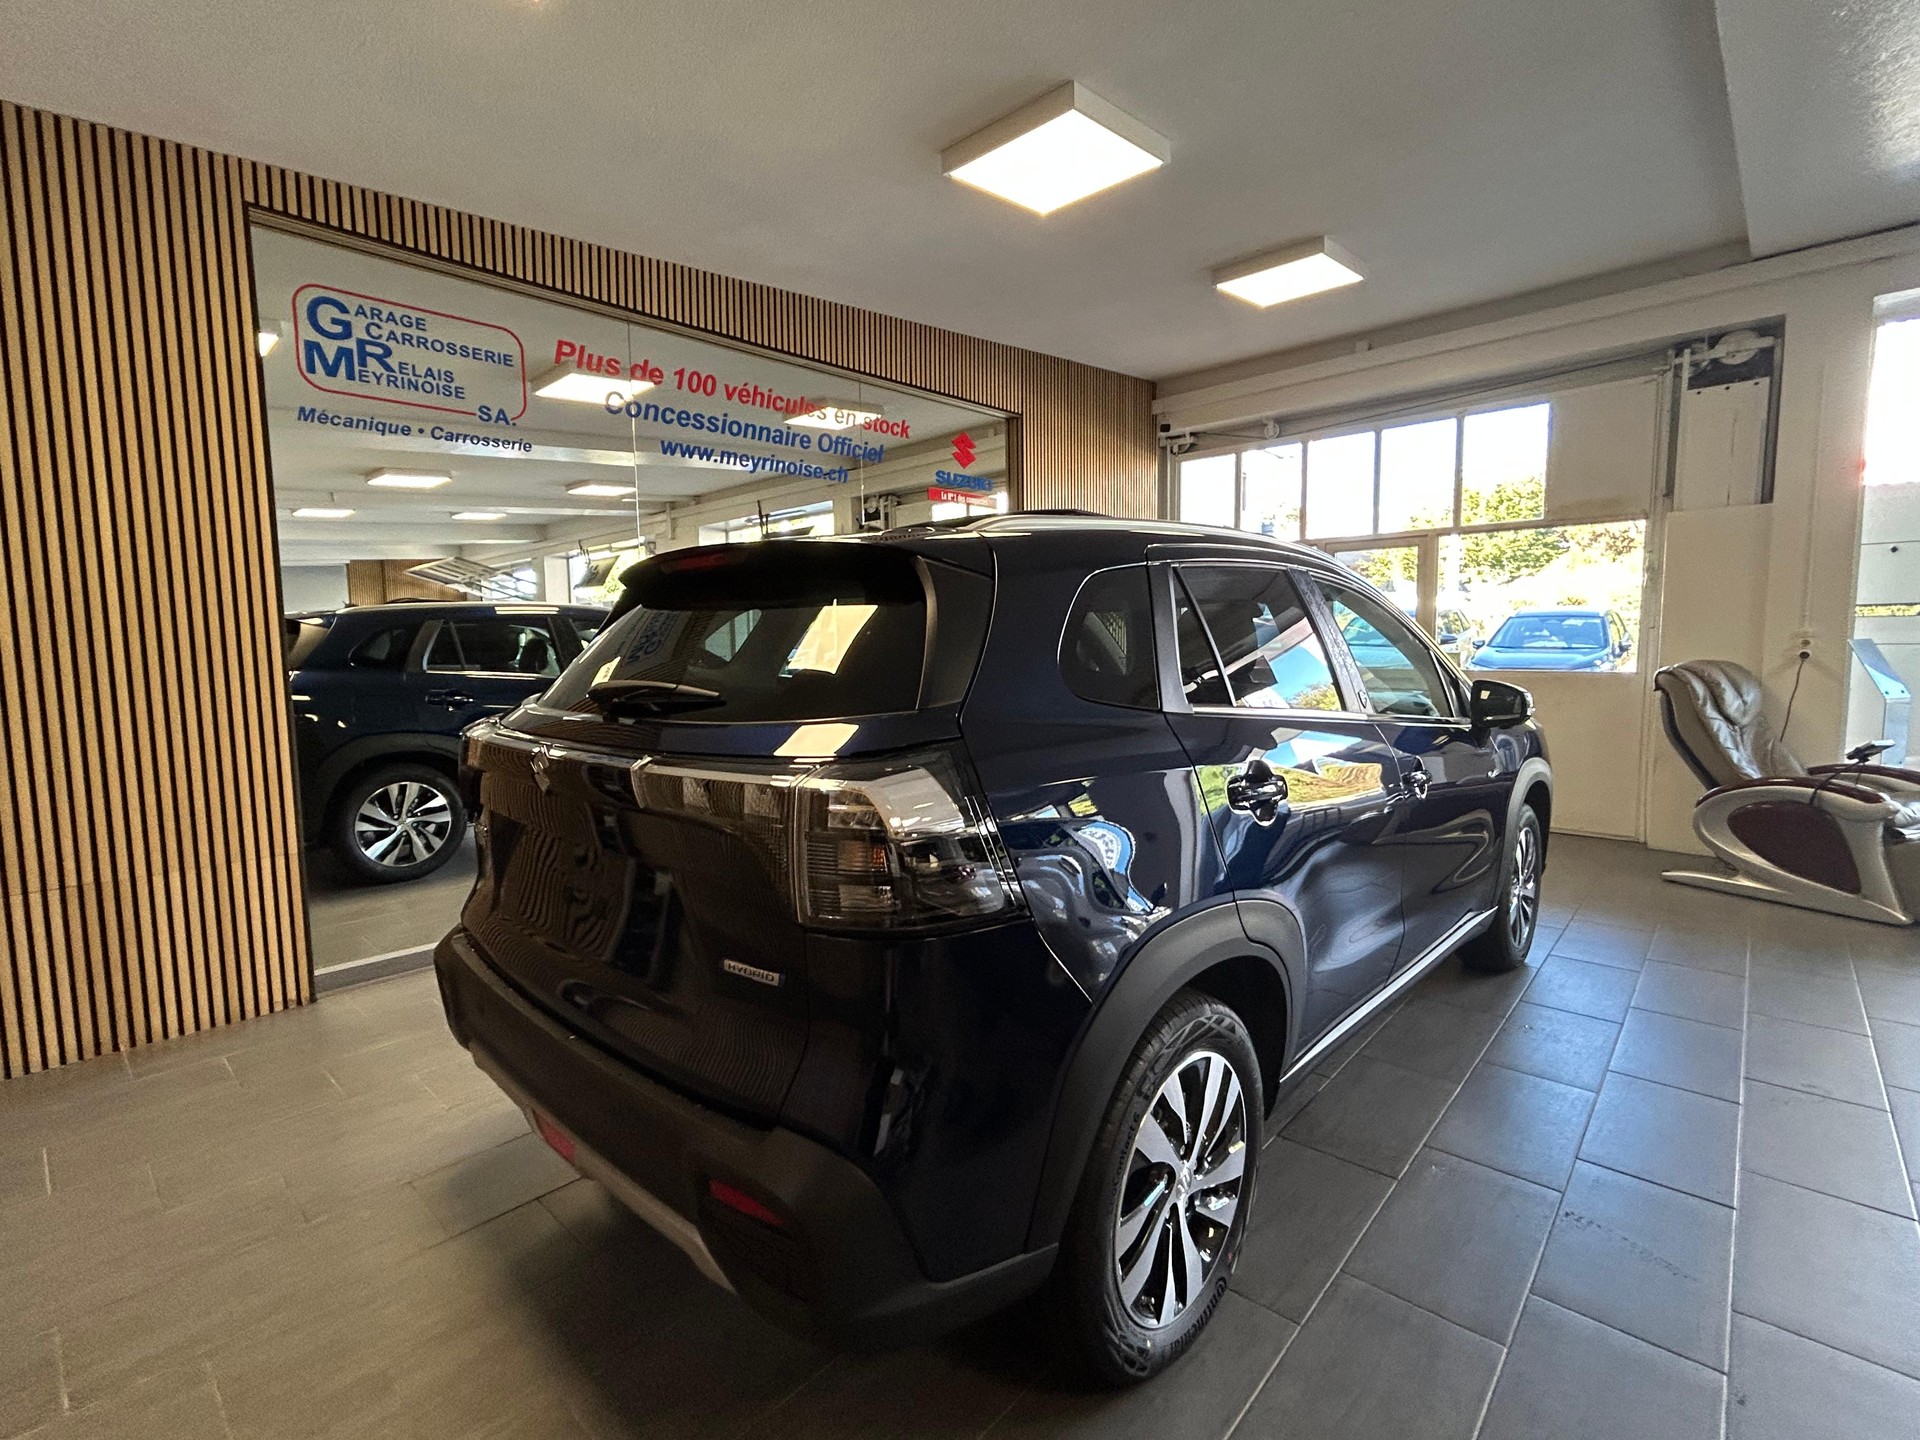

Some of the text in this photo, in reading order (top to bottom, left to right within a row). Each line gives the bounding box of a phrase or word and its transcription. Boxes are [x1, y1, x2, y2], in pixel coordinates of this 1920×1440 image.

[306, 296, 427, 340] GARAGE
[356, 337, 455, 384] RELAIS
[364, 321, 514, 367] CARROSSERIE
[303, 339, 466, 400] MEYRINOISE
[554, 339, 911, 439] Plus de 100 véhicules en stock
[297, 406, 533, 452] Mécanique Carrosserie
[605, 391, 885, 463] Concessionnaire Officiel
[660, 440, 849, 484] www.meyrinoise.ch
[935, 469, 993, 492] SUZUKI
[727, 961, 775, 983] HYBRID
